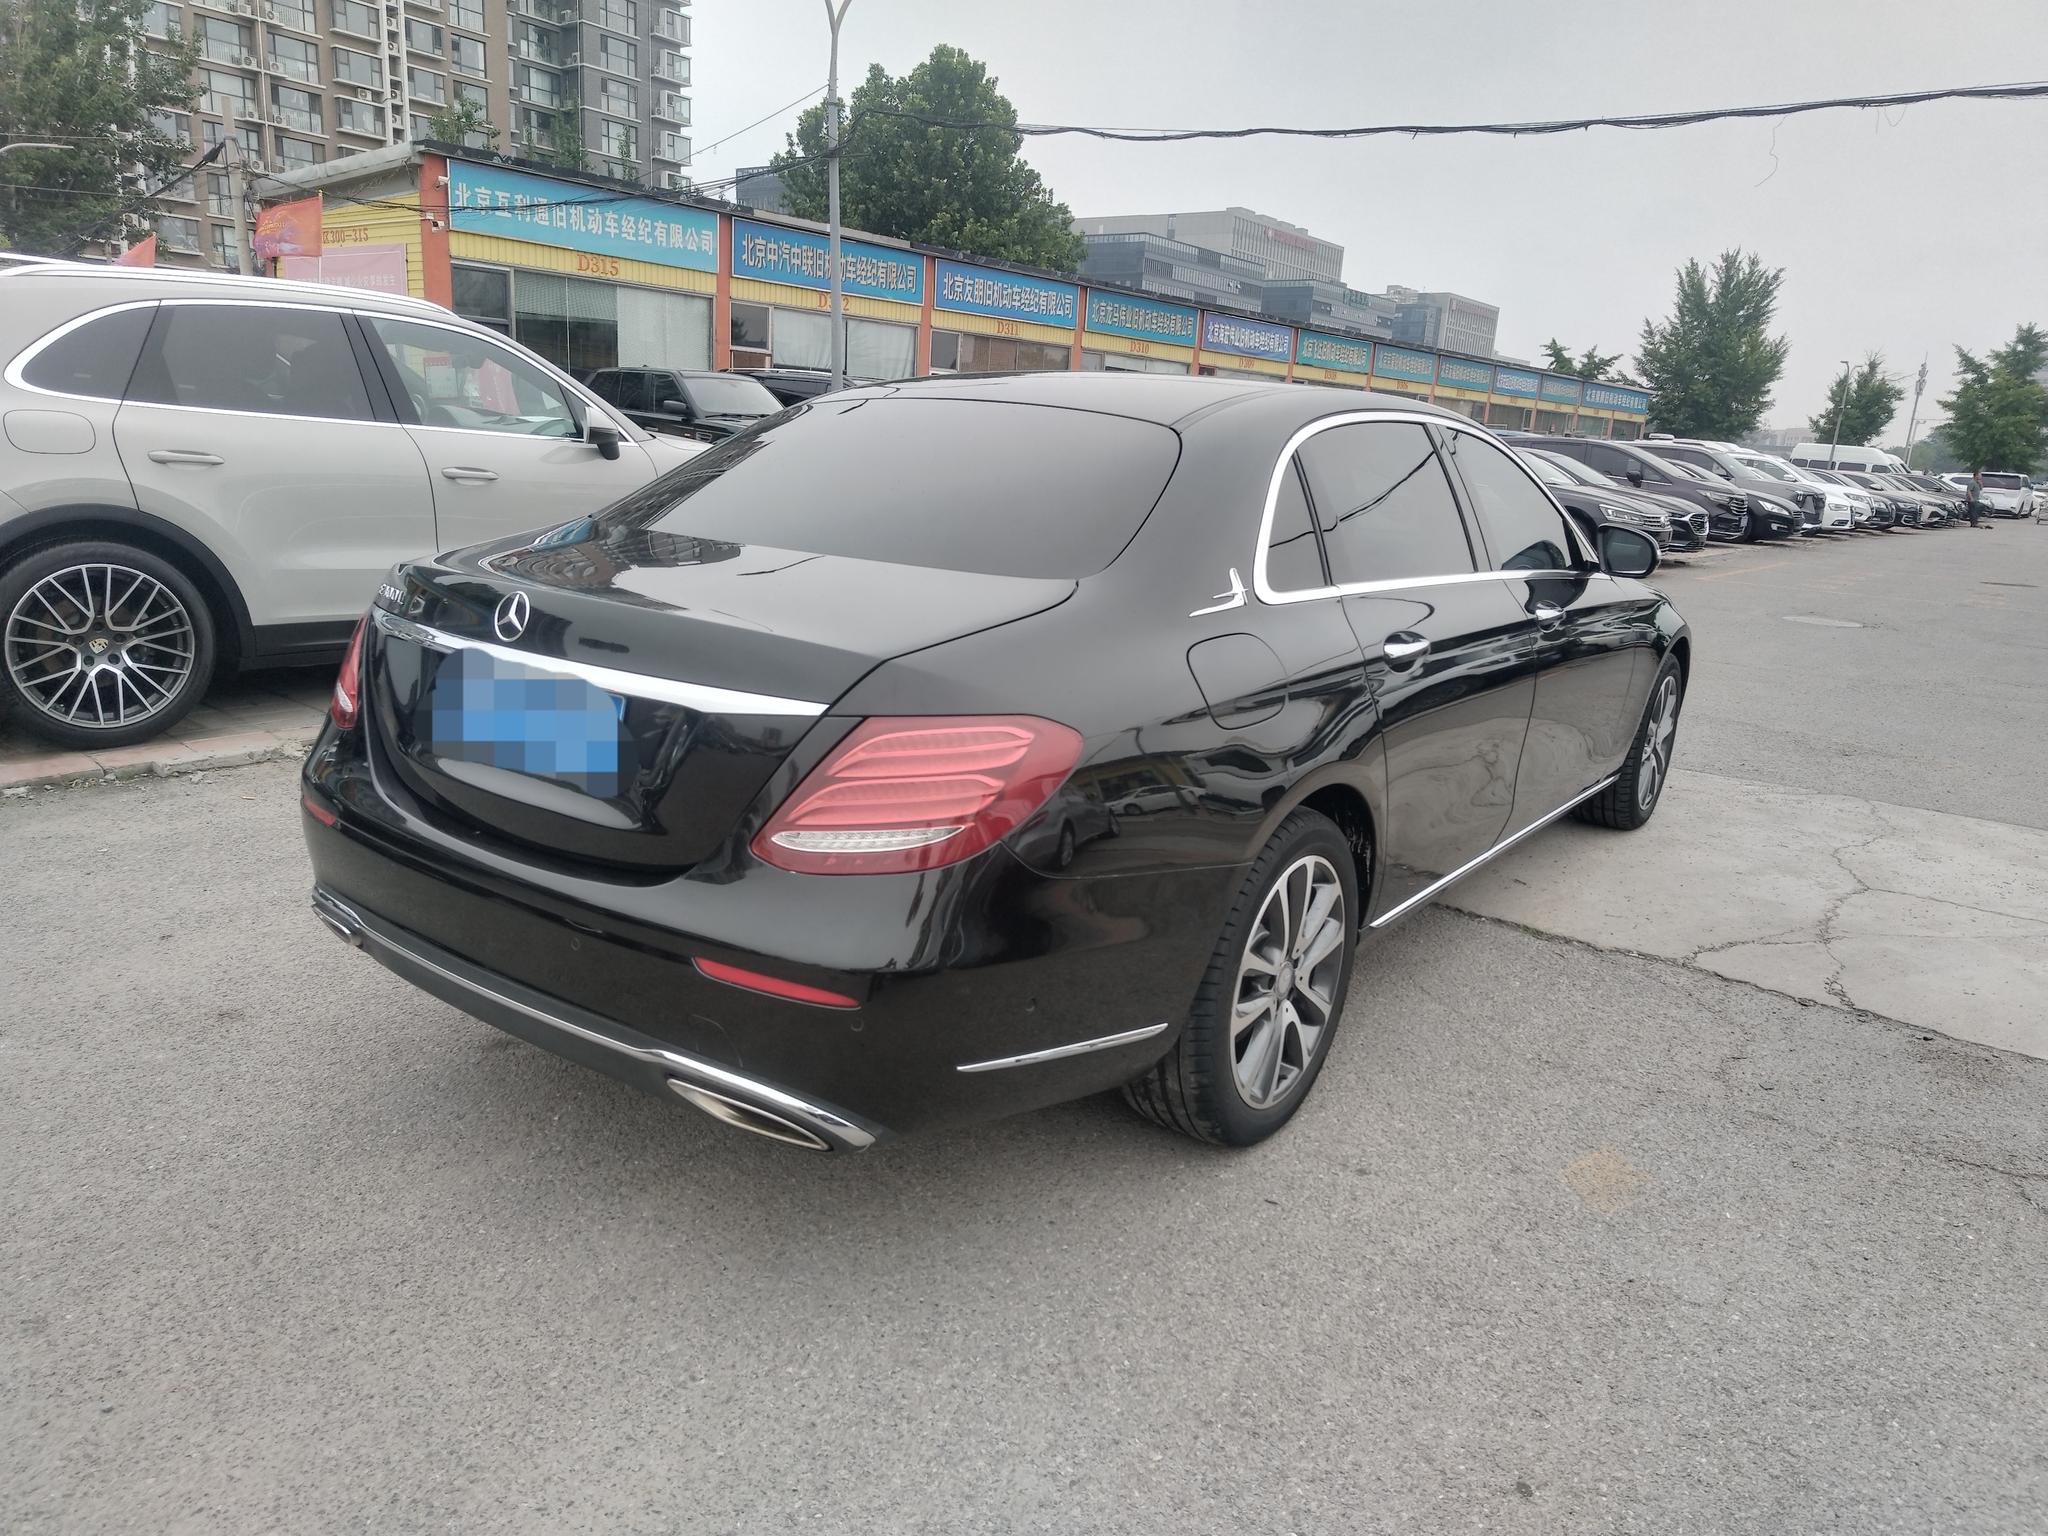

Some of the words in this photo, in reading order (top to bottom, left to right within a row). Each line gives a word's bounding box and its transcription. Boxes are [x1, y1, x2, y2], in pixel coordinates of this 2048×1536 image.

[576, 253, 620, 277] D315
[816, 292, 850, 311] D2
[942, 272, 1074, 320] 北京友朋旧机动车经纪有限公司
[996, 320, 1020, 336] D311
[1130, 341, 1150, 353] D310
